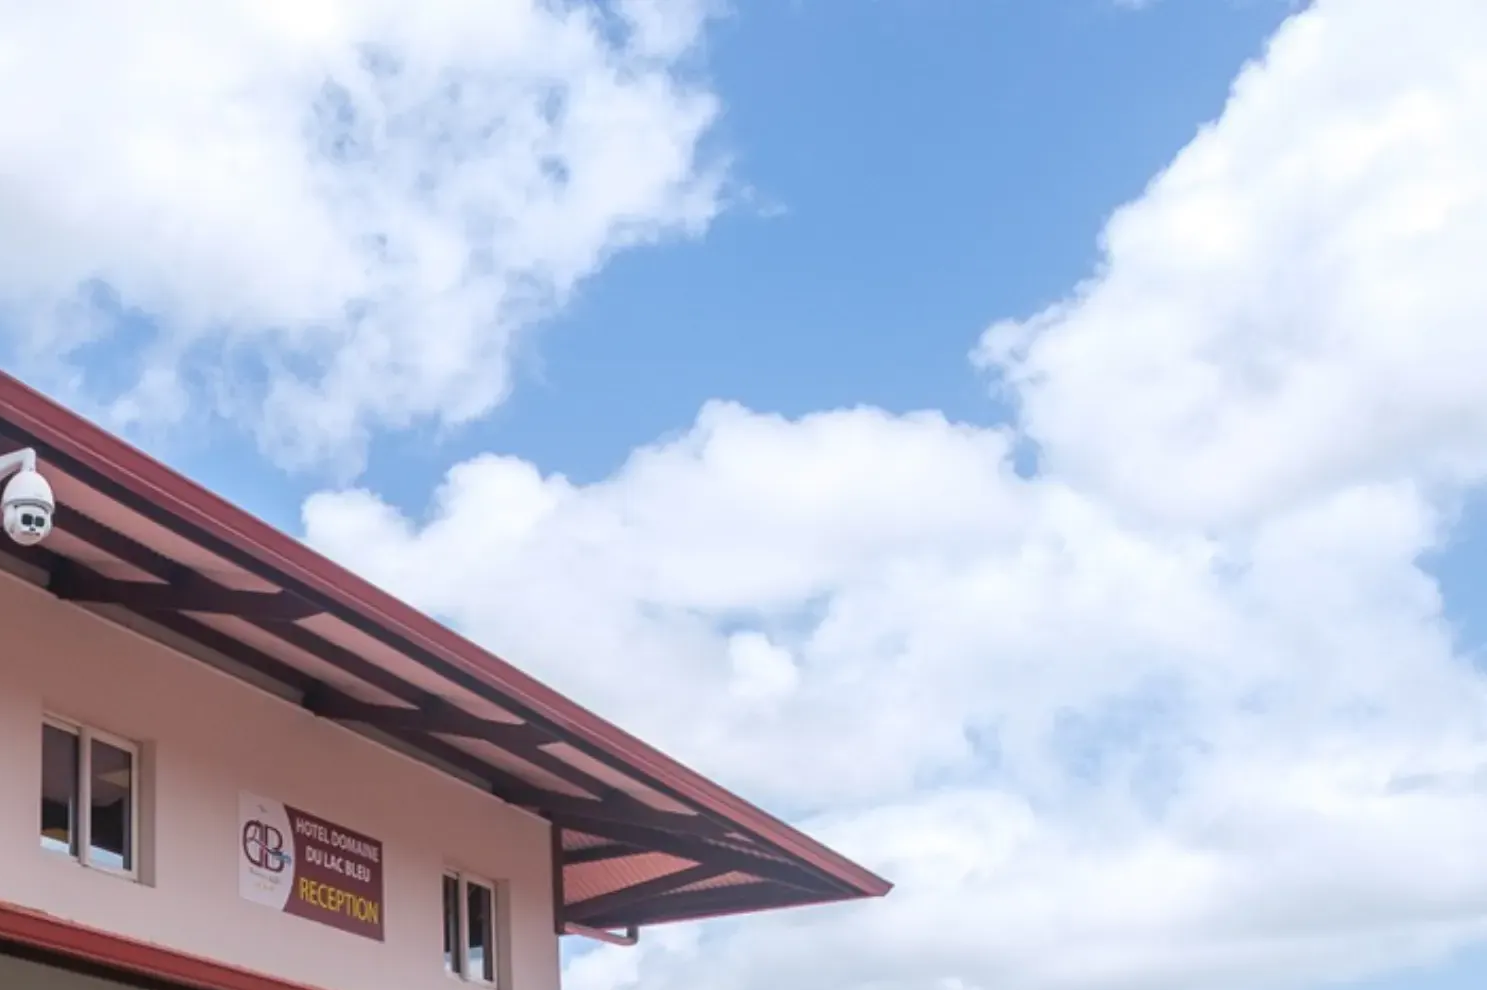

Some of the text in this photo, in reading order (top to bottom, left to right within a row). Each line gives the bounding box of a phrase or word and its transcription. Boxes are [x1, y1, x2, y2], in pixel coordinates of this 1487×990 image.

[296, 817, 379, 863] HOTEL DOMAINE
[305, 845, 371, 883] DU LAC BLEU
[299, 877, 379, 924] RECEPTION
